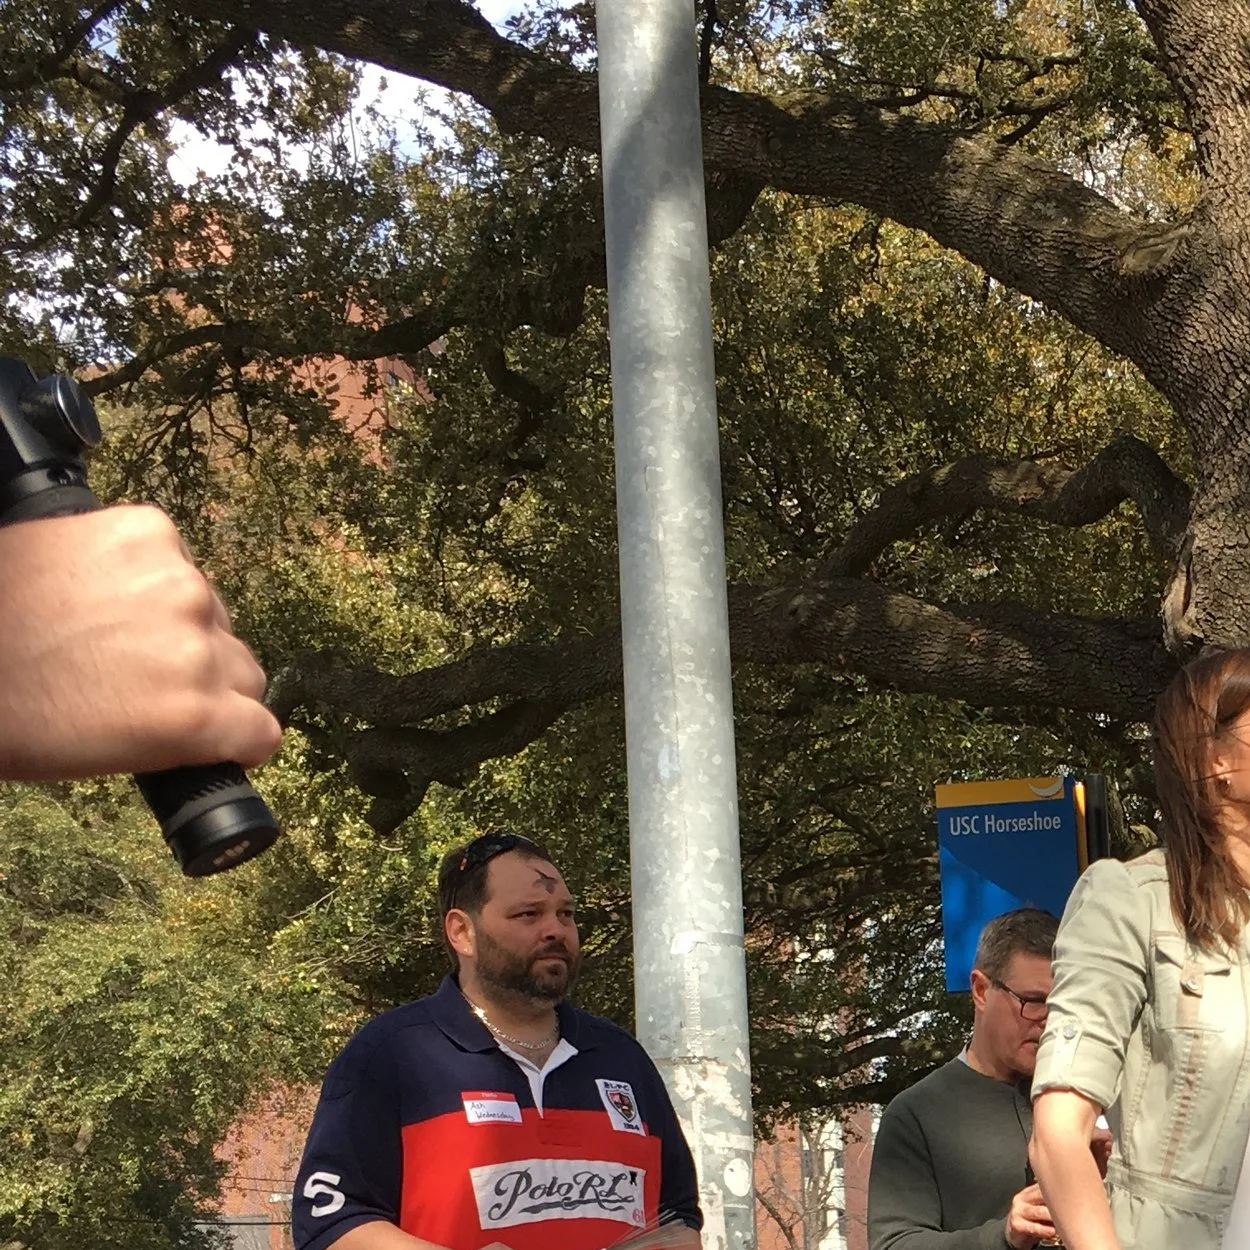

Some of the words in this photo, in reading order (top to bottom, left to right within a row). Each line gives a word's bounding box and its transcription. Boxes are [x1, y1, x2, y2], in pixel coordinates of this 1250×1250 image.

[950, 816, 980, 836] USC
[984, 811, 1061, 834] Horseshoe
[303, 1171, 346, 1218] 5
[488, 1166, 574, 1221] Polo
